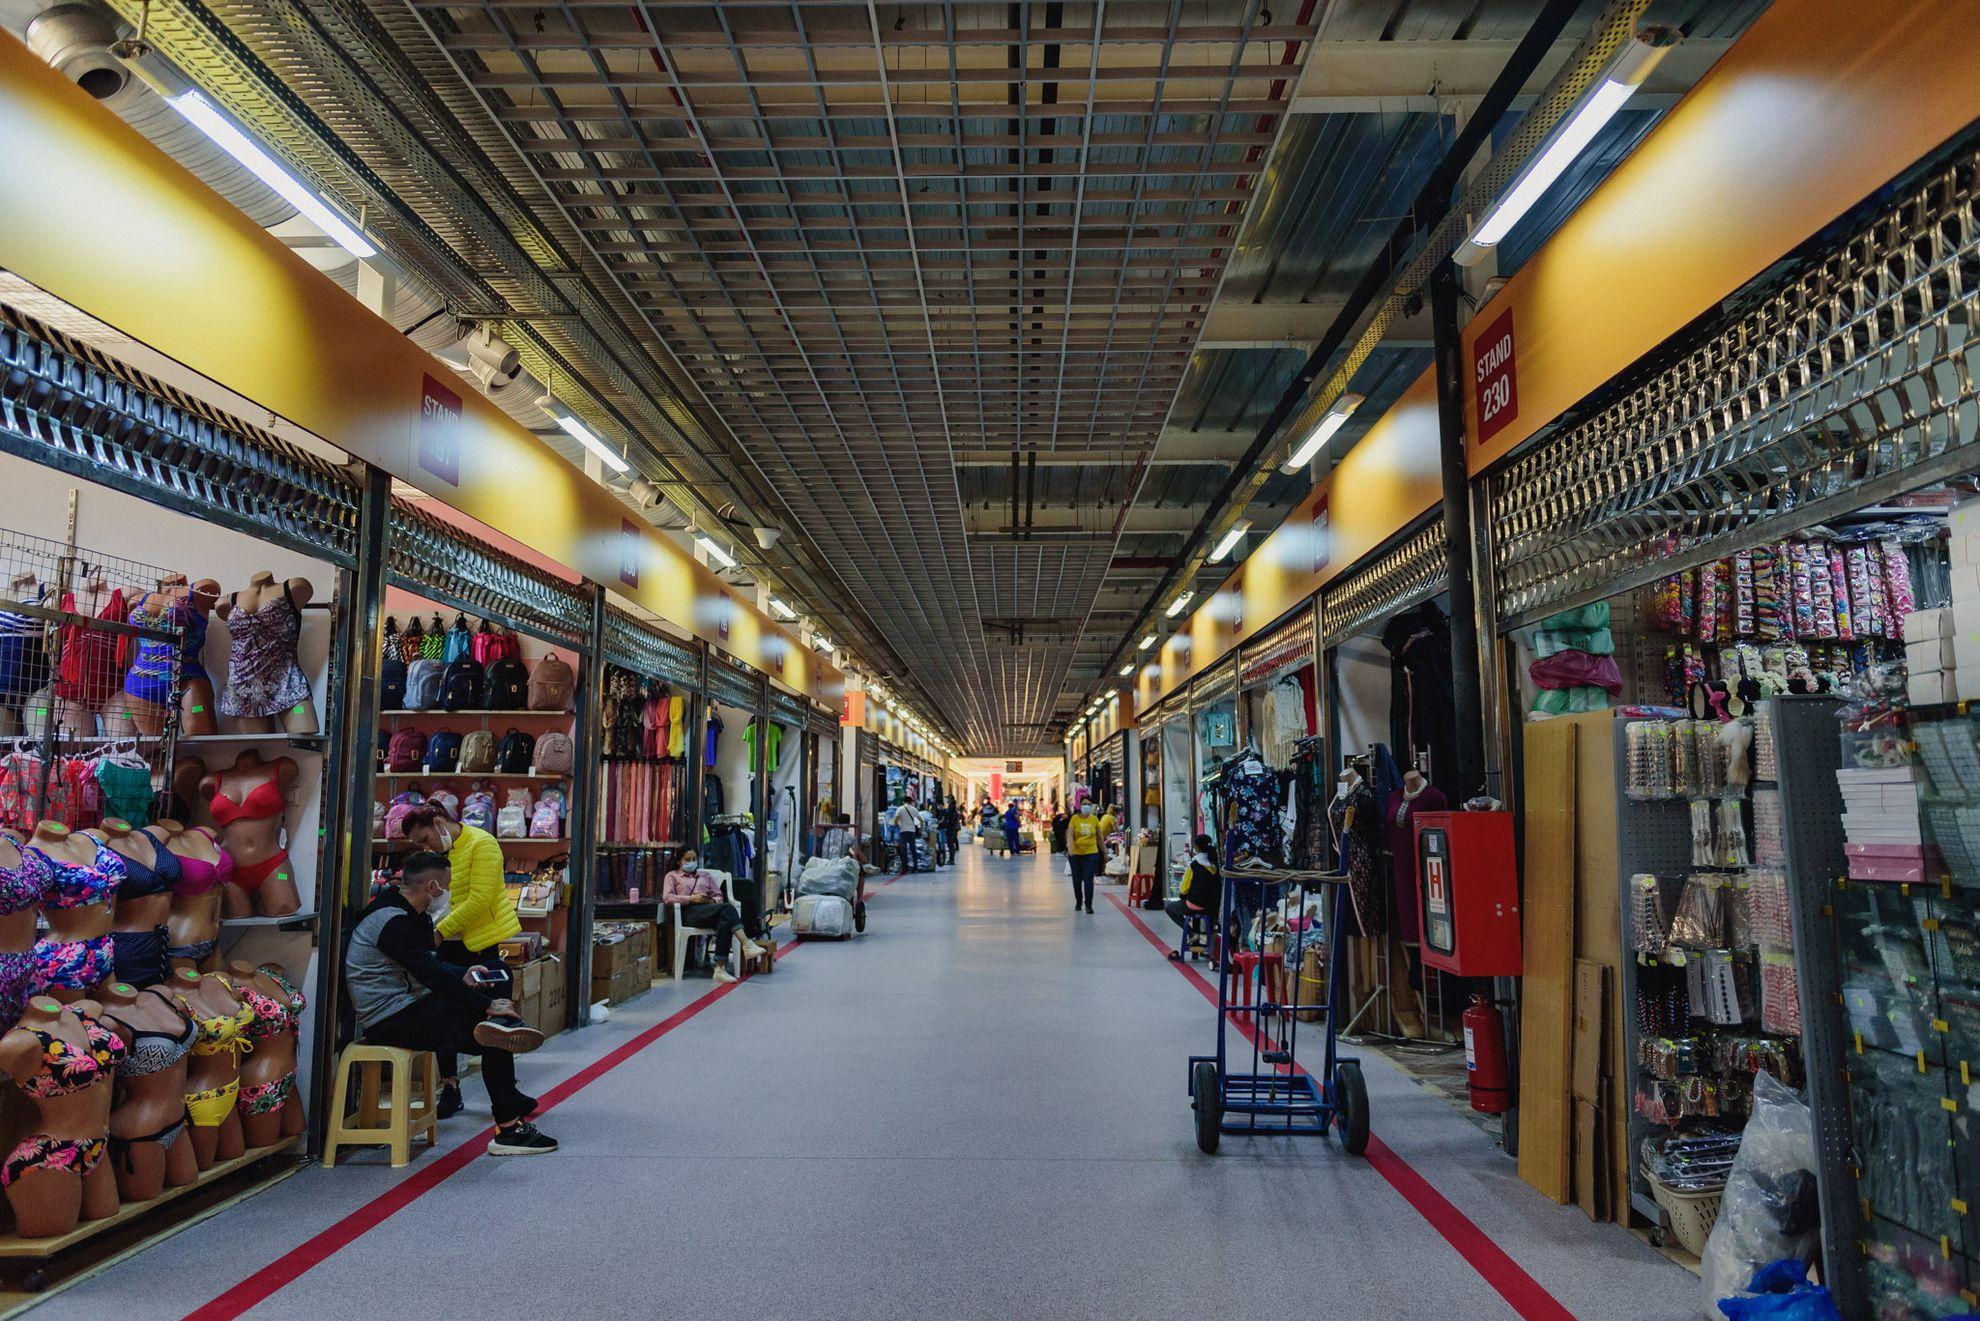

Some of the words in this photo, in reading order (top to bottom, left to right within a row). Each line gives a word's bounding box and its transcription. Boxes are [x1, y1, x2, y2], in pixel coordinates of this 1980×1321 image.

[1477, 334, 1511, 382] STAND
[1483, 373, 1510, 422] 230
[1429, 861, 1443, 899] H
